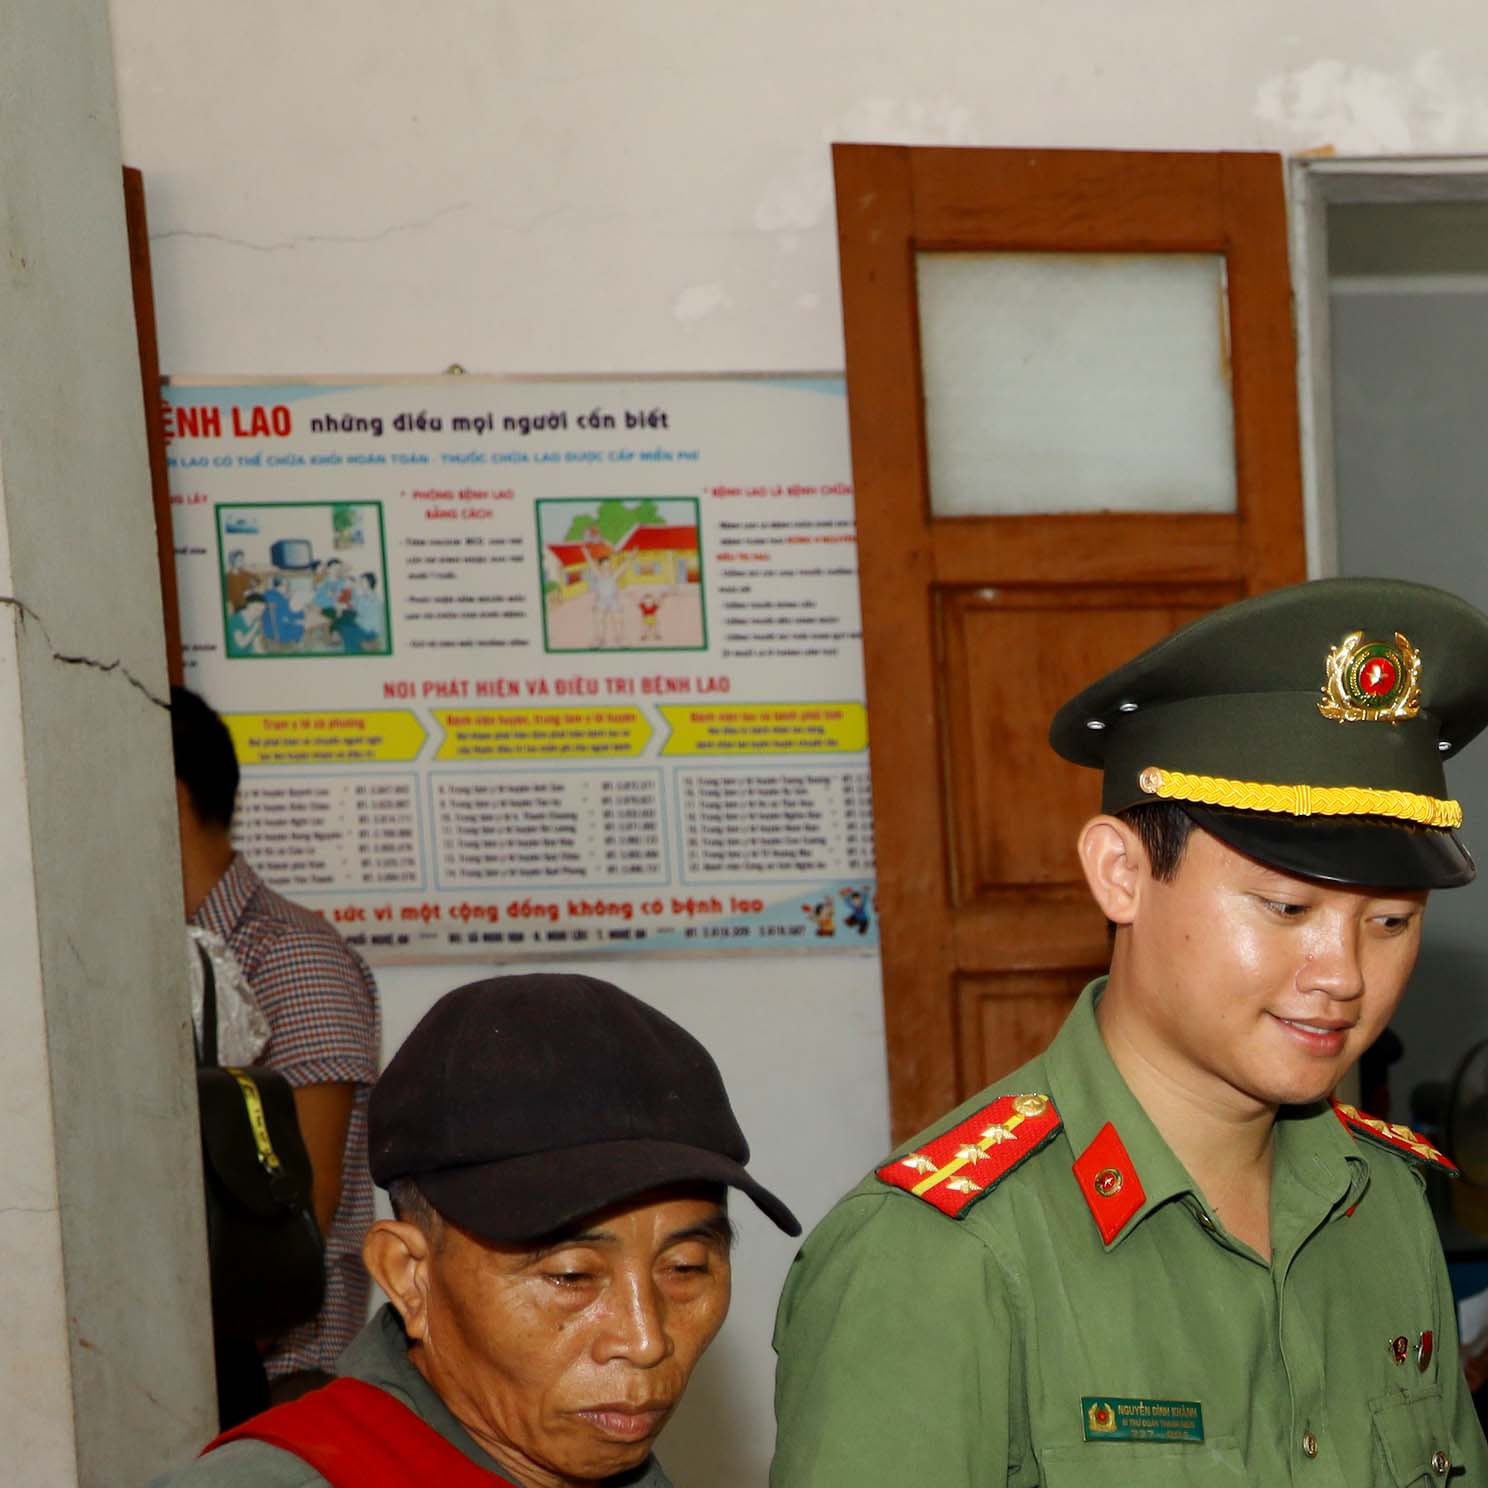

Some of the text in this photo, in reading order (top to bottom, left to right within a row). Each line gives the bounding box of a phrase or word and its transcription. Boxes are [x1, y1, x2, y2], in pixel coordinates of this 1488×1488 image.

[162, 402, 221, 445] ỆNH
[232, 404, 292, 437] LAO
[311, 413, 384, 437] những
[453, 413, 493, 435] mọi
[504, 411, 567, 435] người
[626, 407, 669, 429] biết
[181, 454, 208, 467] LAO
[214, 452, 232, 467] CÓ
[422, 677, 469, 699] PHÁT
[476, 676, 519, 699] HIỆN
[526, 676, 549, 696] VÀ
[554, 674, 598, 696] ĐIỀU
[604, 676, 635, 697] TRỊ
[641, 674, 690, 696] BỆNH
[697, 675, 731, 693] LAO
[333, 905, 365, 921] sức
[374, 904, 392, 921] vì
[401, 902, 441, 924] một
[450, 901, 499, 924] cộng
[568, 899, 633, 919] không
[641, 897, 663, 915] có
[672, 896, 723, 918] bệnh
[731, 896, 764, 914] lao
